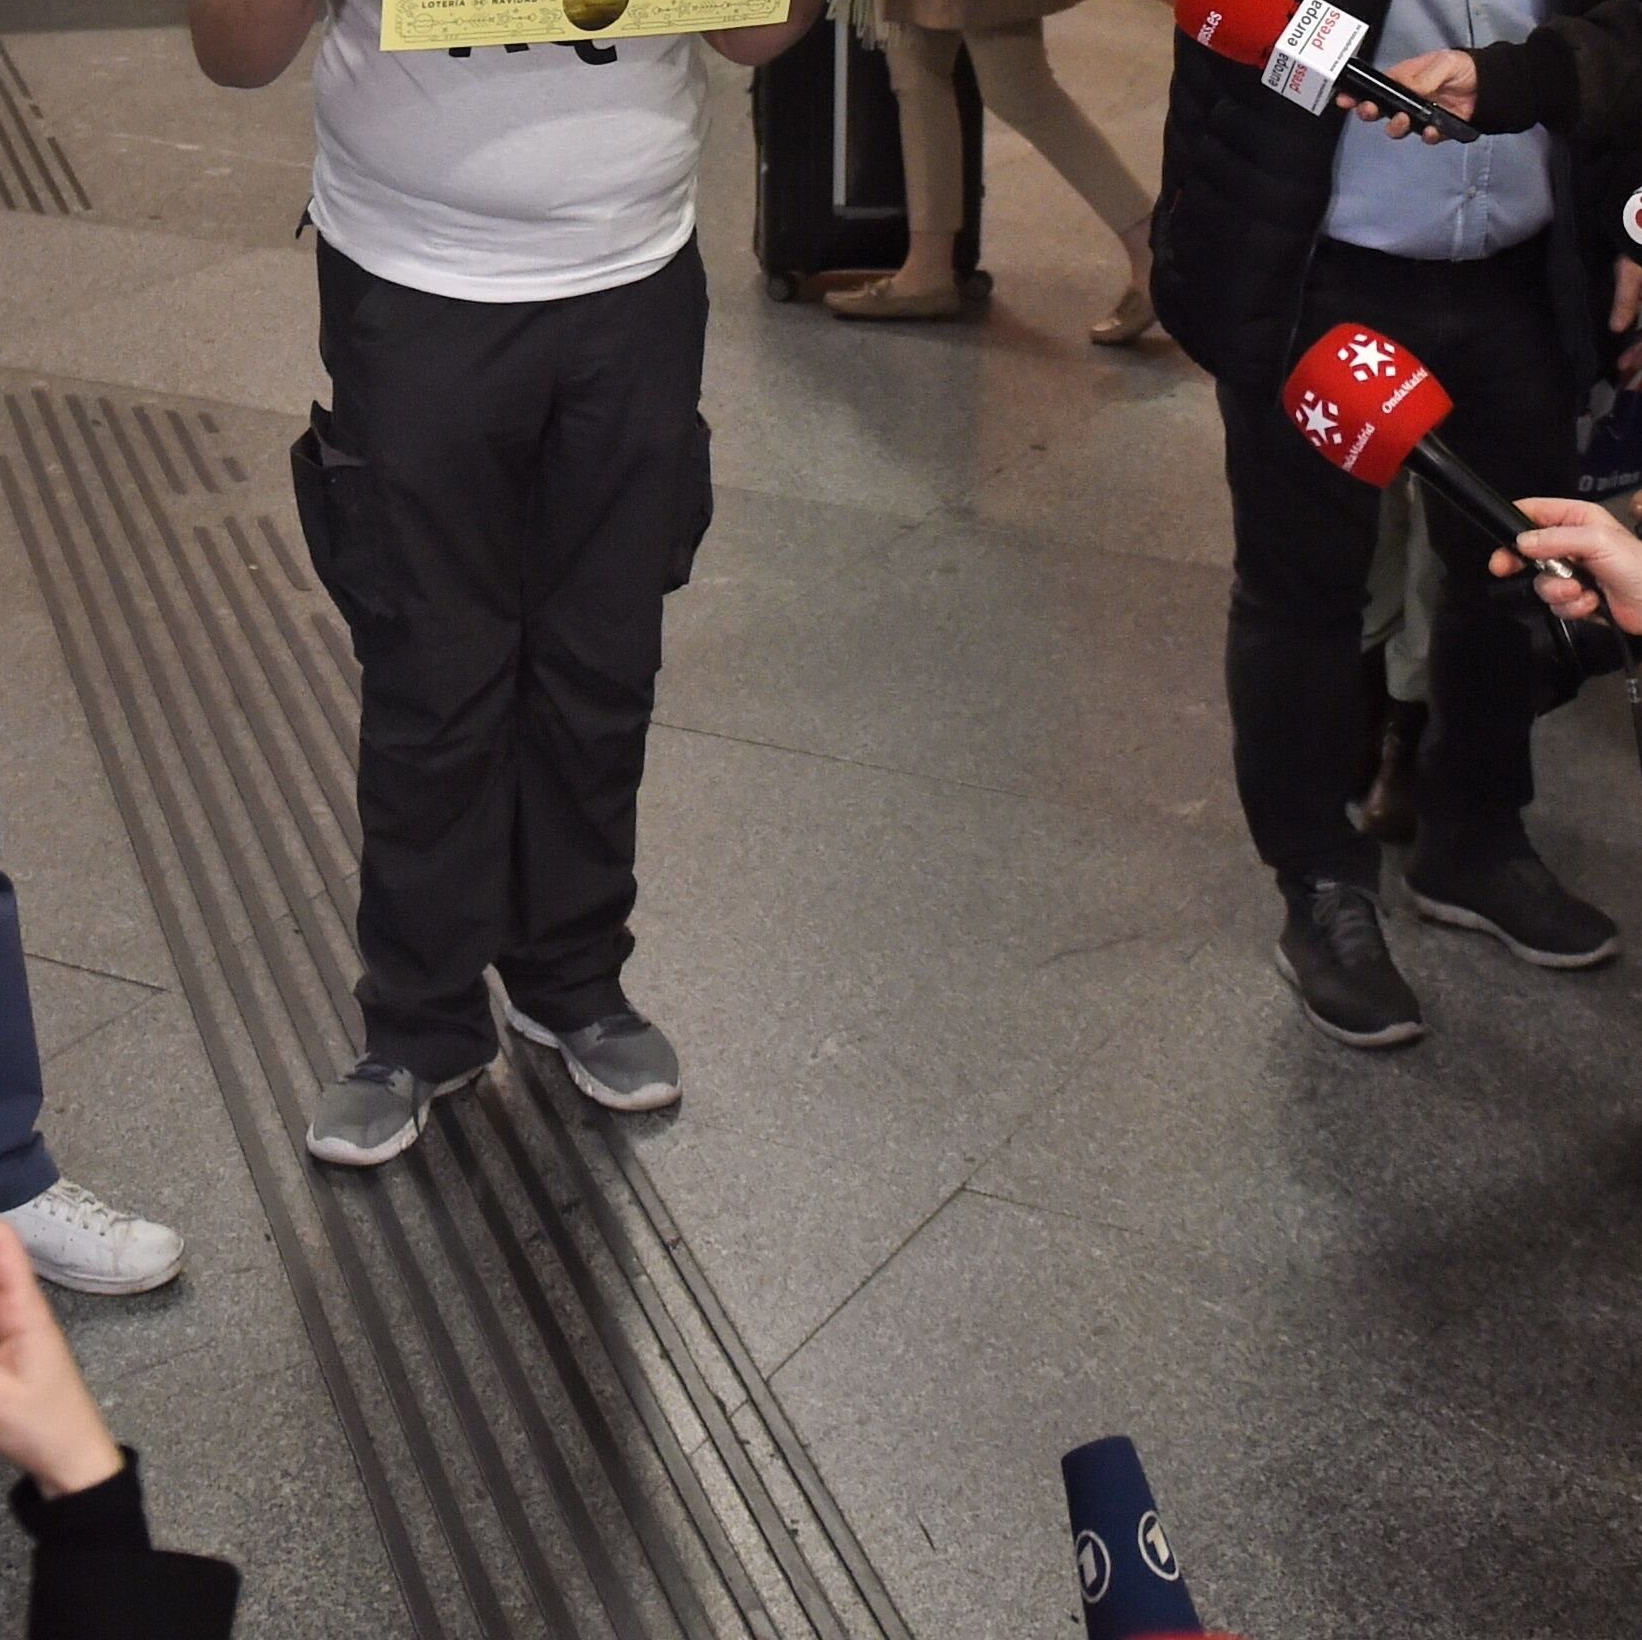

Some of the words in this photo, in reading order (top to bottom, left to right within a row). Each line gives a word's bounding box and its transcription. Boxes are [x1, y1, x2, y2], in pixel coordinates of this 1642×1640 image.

[1311, 10, 1341, 50] press
[1267, 51, 1289, 88] europa
[1289, 62, 1308, 95] press
